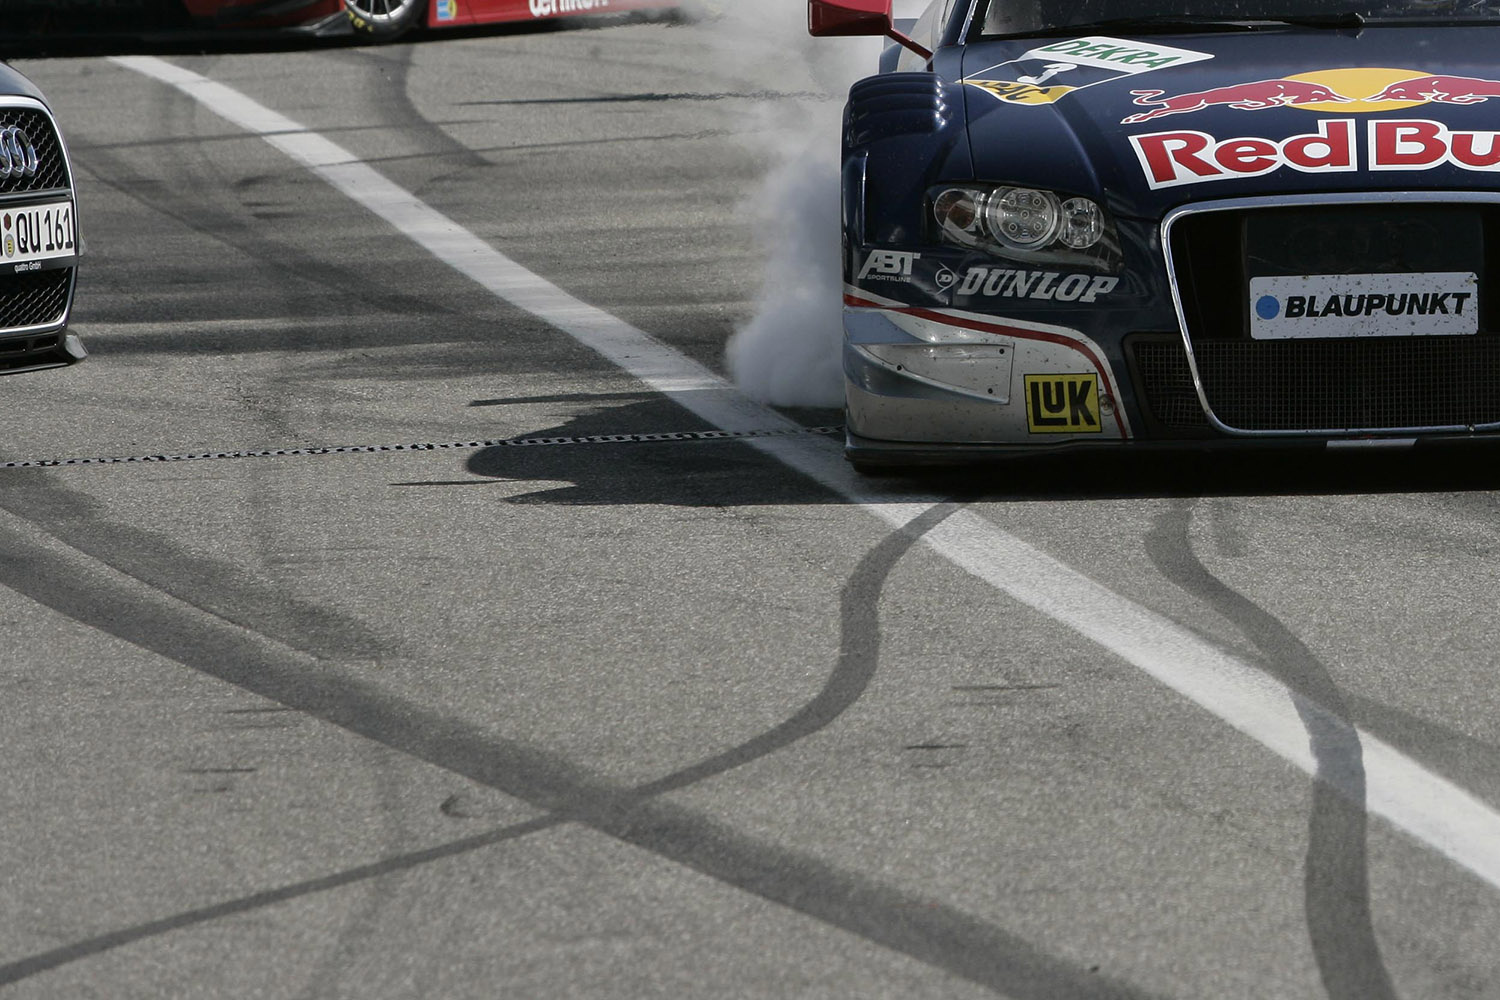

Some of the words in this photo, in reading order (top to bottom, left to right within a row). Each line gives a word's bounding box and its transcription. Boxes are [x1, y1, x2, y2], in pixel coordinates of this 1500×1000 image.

[1039, 40, 1181, 68] DEKRA
[1137, 121, 1352, 183] Red
[857, 249, 921, 279] ABT
[957, 266, 1120, 303] DUNLOP
[1285, 292, 1471, 318] BLAUPUNKT
